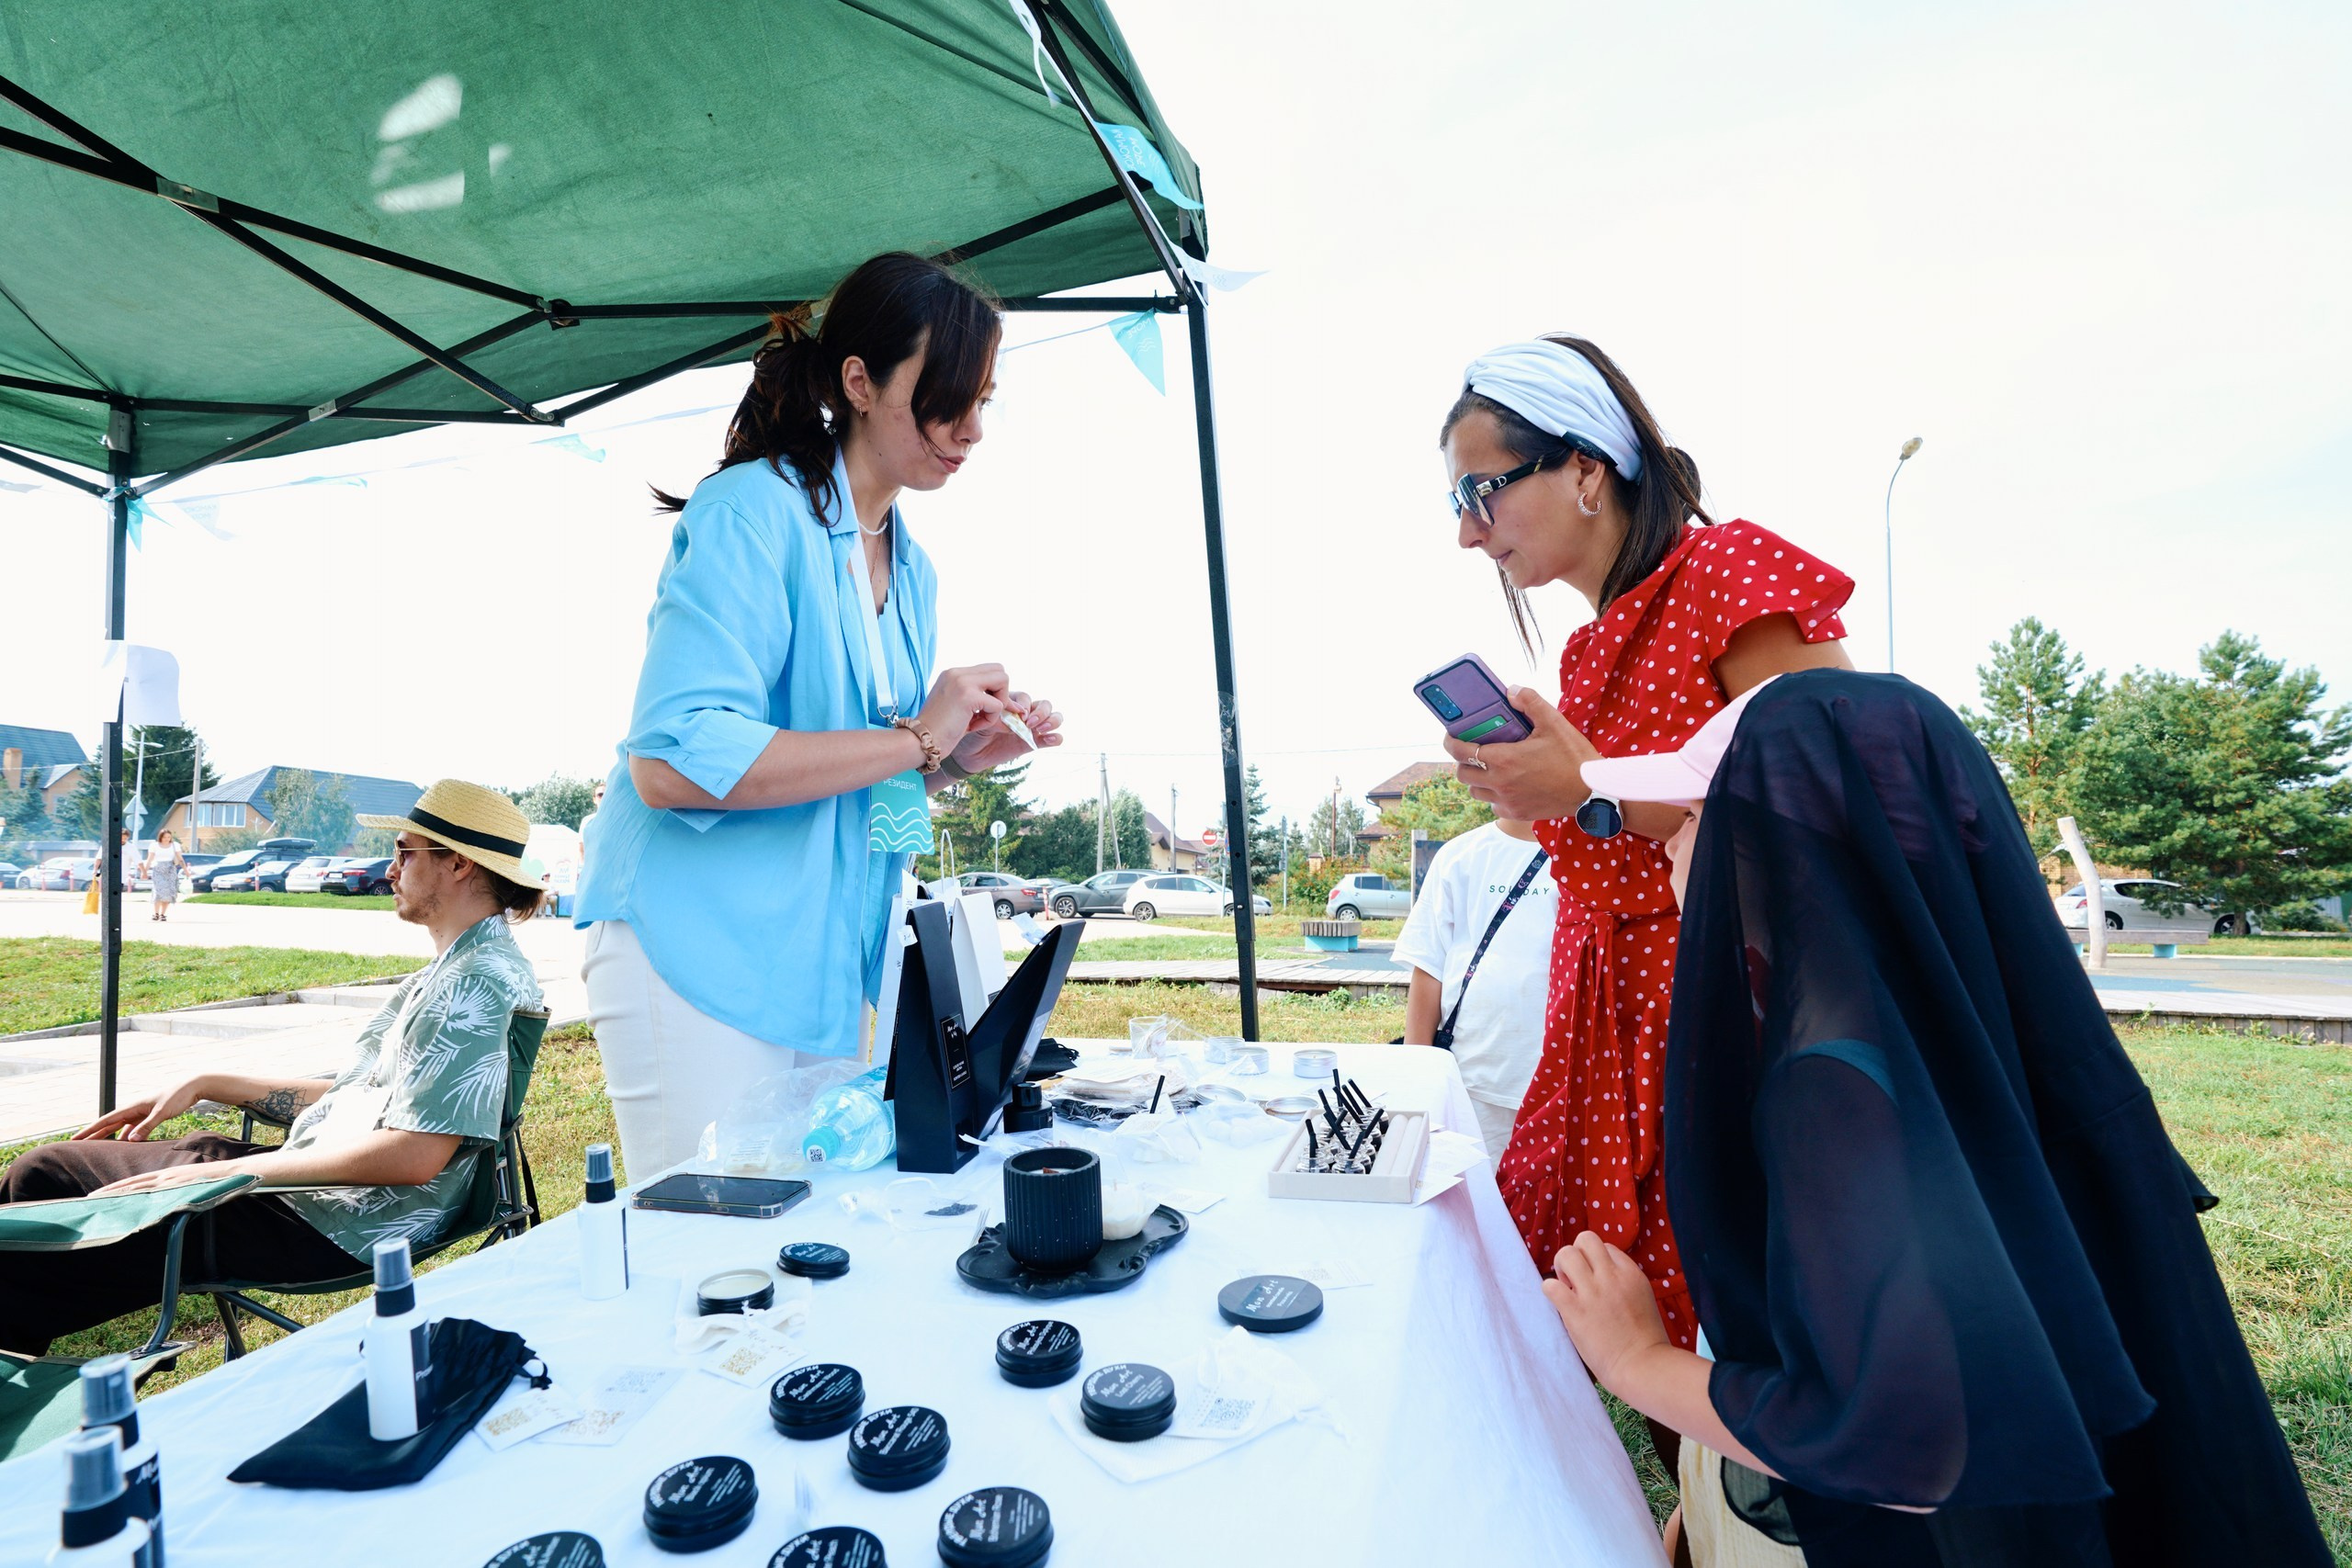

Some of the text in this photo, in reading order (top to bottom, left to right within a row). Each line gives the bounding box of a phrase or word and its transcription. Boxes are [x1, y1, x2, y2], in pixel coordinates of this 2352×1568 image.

[1495, 476, 1507, 488] D
[1246, 1280, 1279, 1312] Mon Art
[1017, 1325, 1038, 1349] Mon Art
[789, 1383, 808, 1397] Mon
[809, 1370, 824, 1383] Art
[1101, 1382, 1119, 1397] Mon
[1119, 1370, 1133, 1383] Art
[870, 1414, 900, 1448] Mon Art
[668, 1466, 703, 1505] Mon Art
[969, 1499, 987, 1541] Mon Art
[805, 1540, 823, 1561] Art
